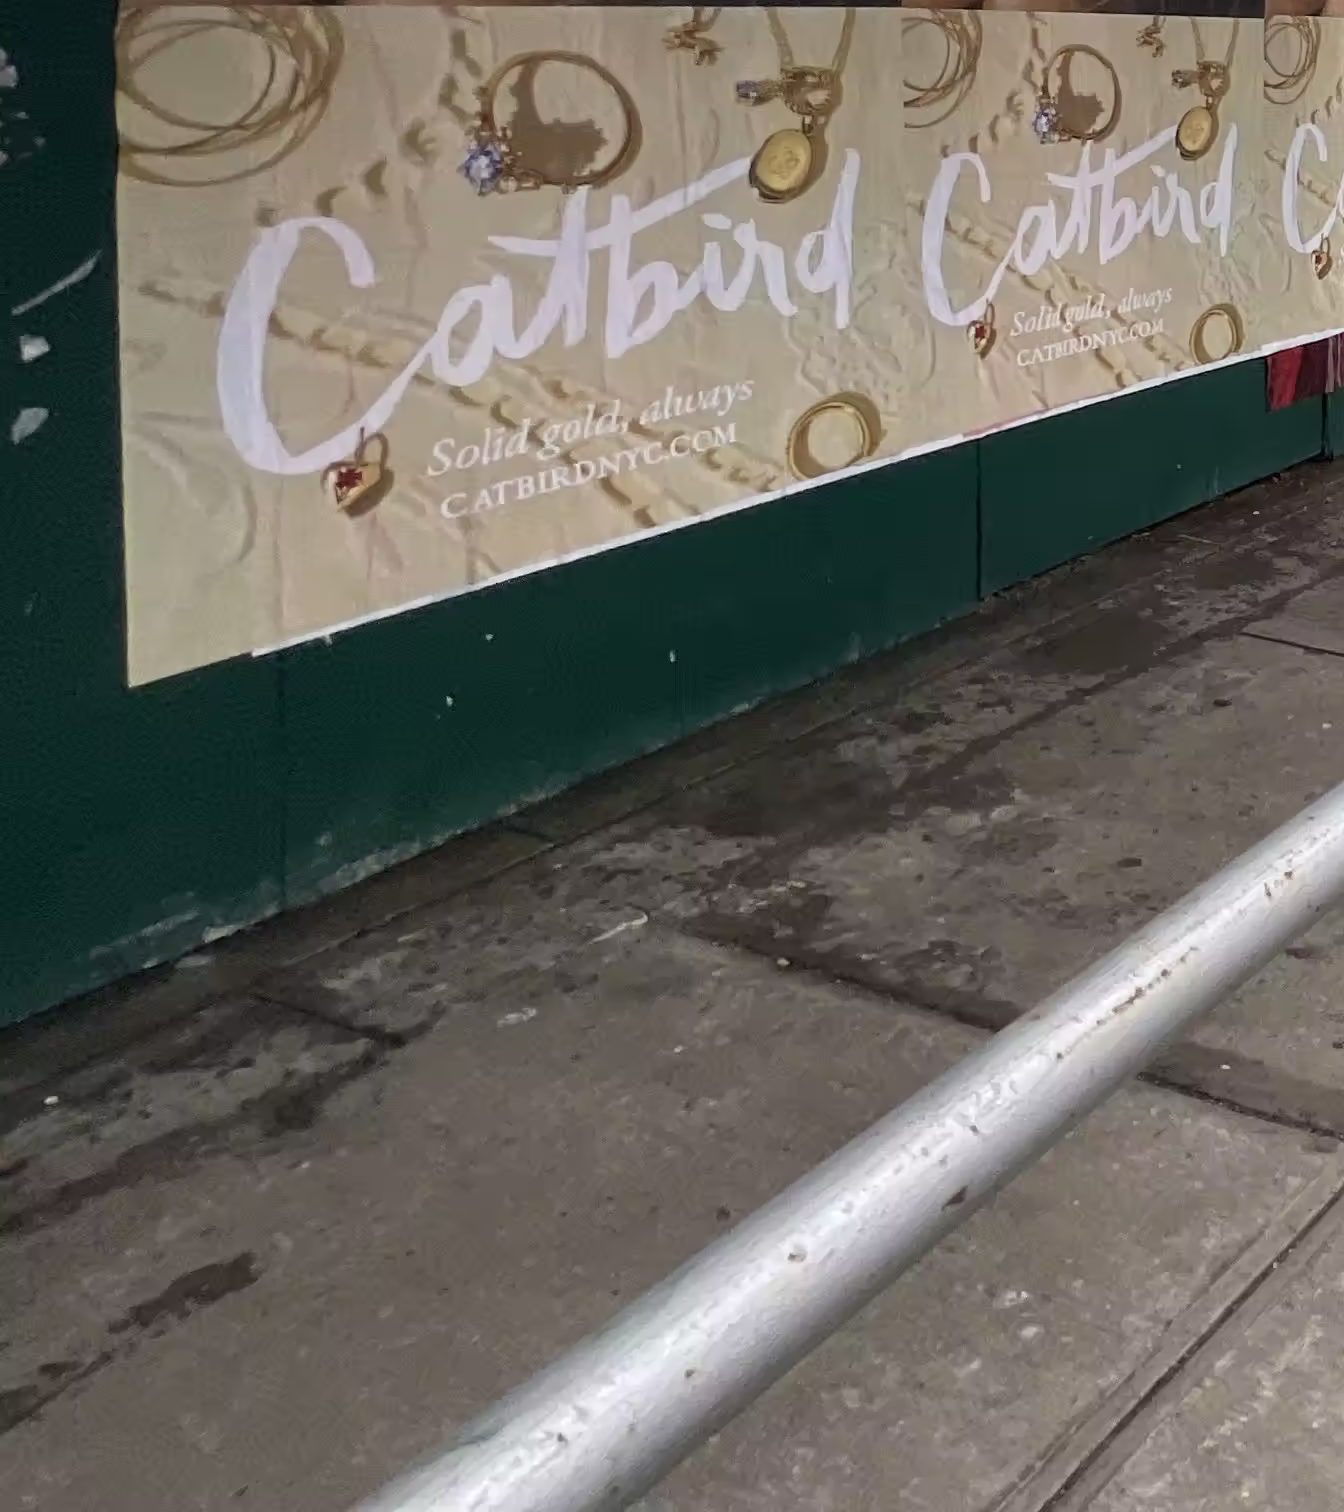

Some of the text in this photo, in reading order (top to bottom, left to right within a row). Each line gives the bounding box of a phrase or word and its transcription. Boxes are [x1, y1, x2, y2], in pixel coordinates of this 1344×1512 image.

[921, 122, 1238, 328] Catbird
[216, 147, 860, 476] Catbird
[1010, 302, 1062, 337] Solid
[1117, 287, 1173, 314] always
[427, 379, 756, 478] Solid gold, always
[439, 422, 738, 519] CATBIRDNYC.COM
